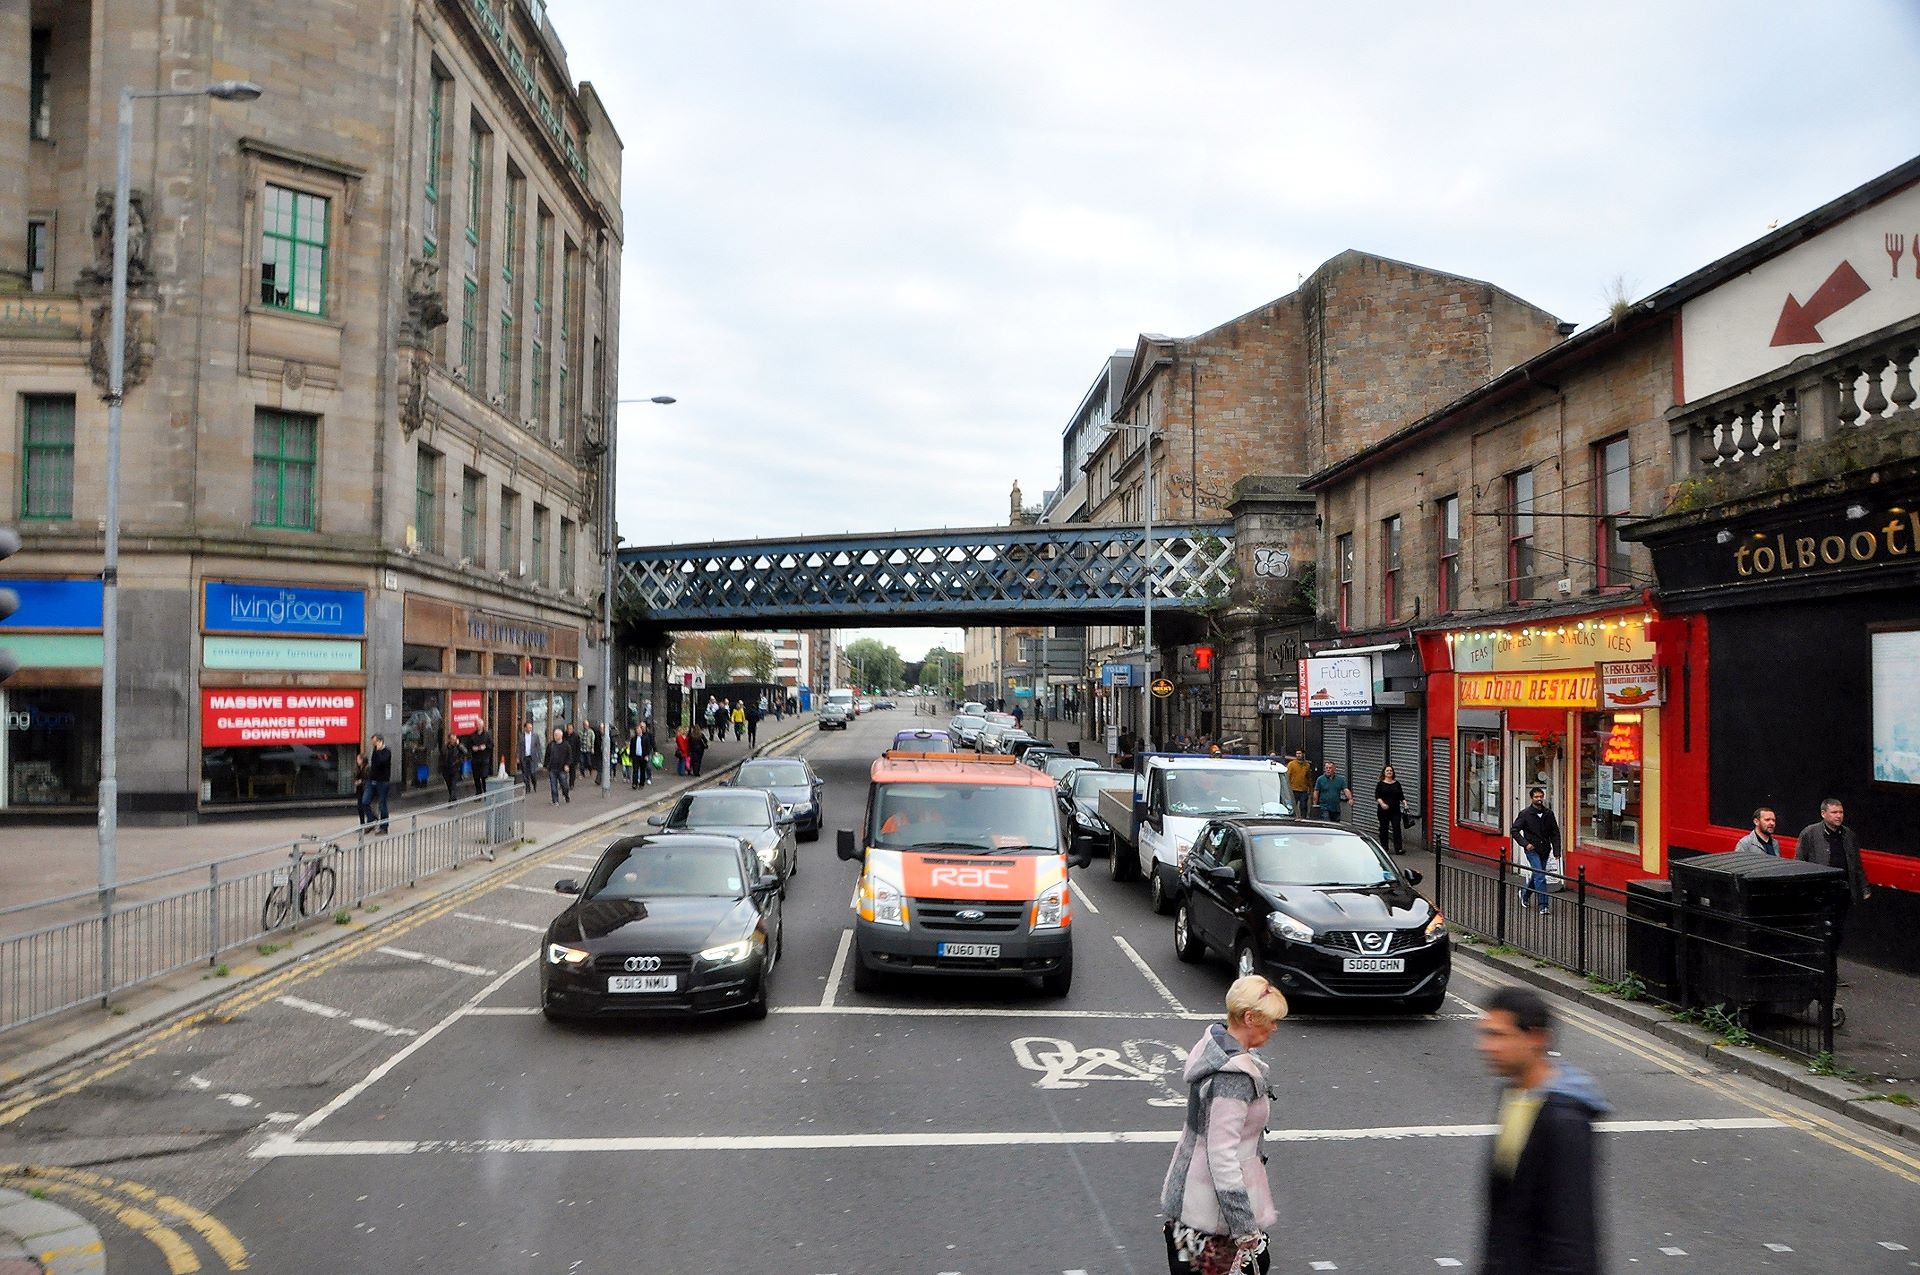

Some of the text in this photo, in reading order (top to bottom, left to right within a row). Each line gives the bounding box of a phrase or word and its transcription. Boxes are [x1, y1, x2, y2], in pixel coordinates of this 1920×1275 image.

[213, 647, 281, 659] contemporary
[287, 648, 328, 659] furniture
[1470, 630, 1632, 663] TEAS COFFEES SNACKS ICES
[1321, 666, 1361, 679] Future
[1610, 663, 1650, 674] FISH & CHIPS
[210, 696, 354, 709] MASSIVE SAVINGS
[217, 716, 348, 729] CLEARANCE CENTRE
[241, 728, 326, 740] DOWNSTAIRS
[946, 944, 999, 957] VU60 TVE
[1348, 959, 1400, 970] SD60 GHN
